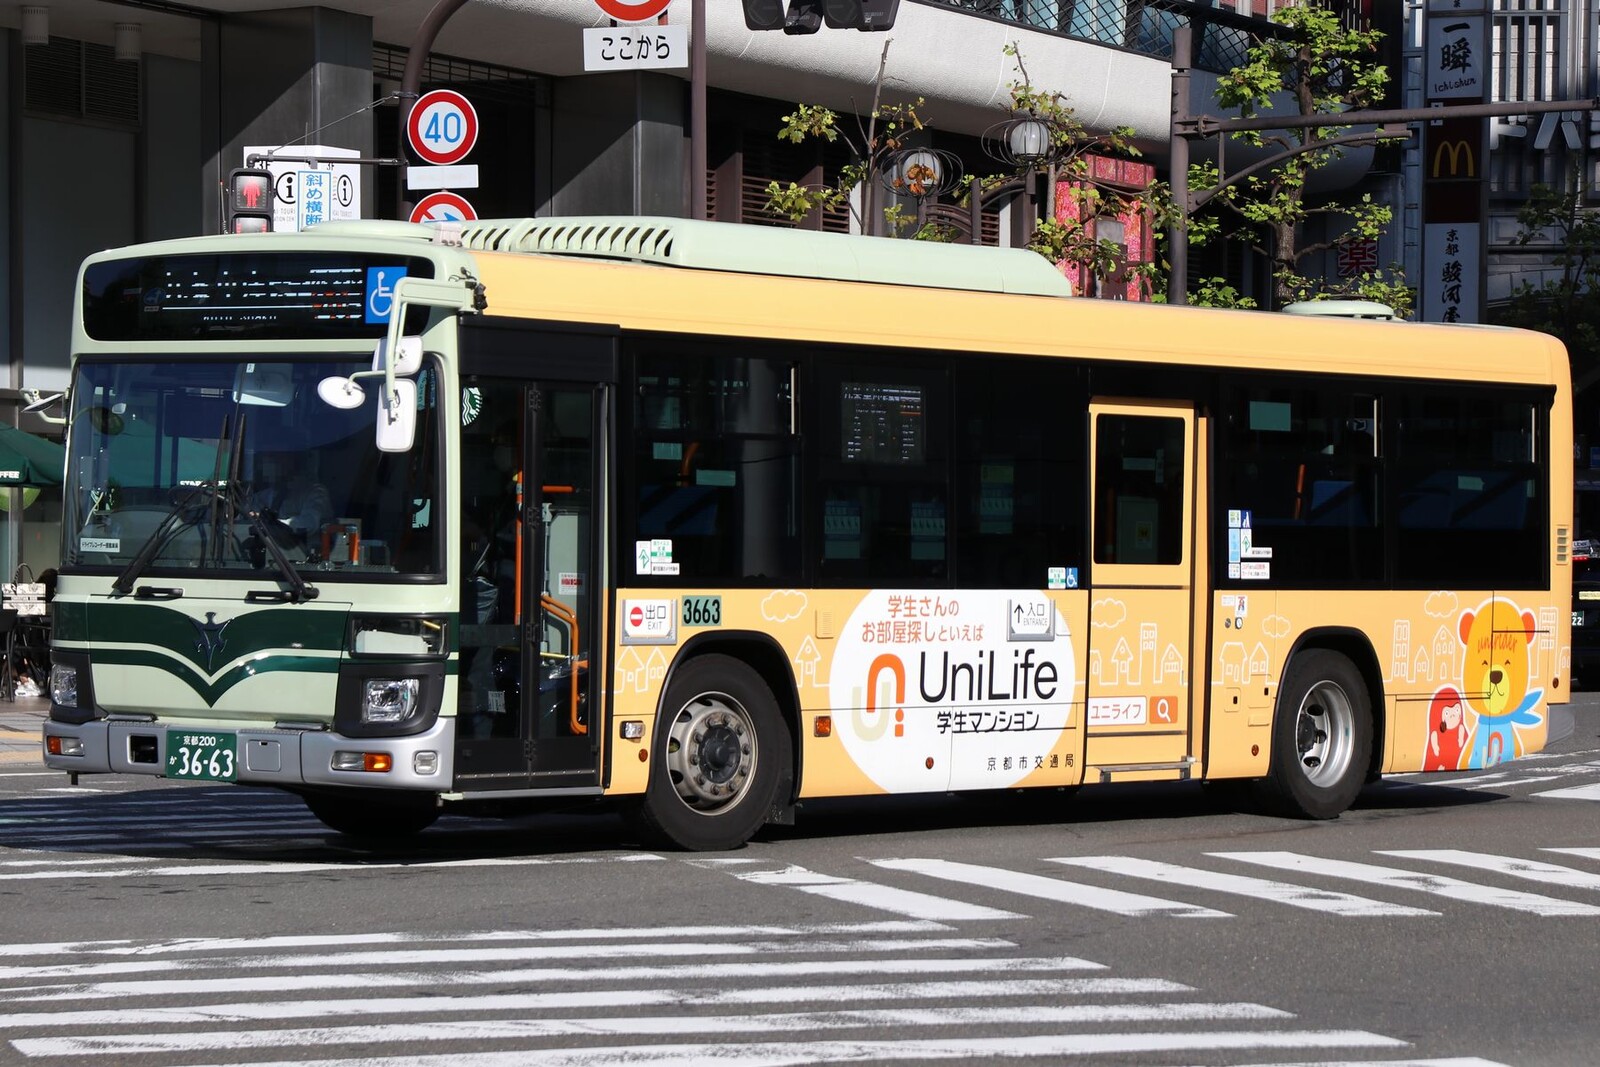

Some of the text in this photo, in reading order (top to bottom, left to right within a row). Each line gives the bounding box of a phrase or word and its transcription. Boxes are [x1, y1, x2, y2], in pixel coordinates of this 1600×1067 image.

[601, 34, 670, 60] ここから
[1440, 22, 1472, 74] 一瞬
[425, 112, 461, 143] 40
[645, 605, 666, 619] 出口
[684, 599, 720, 624] 3663
[888, 596, 959, 618] 学生さんの
[1027, 602, 1045, 616] 入口
[647, 621, 662, 630] EXIT
[862, 621, 984, 644] お部屋探しといえば
[1023, 618, 1048, 626] ENTRANCE
[919, 649, 1058, 702] UniLife
[937, 711, 1039, 734] 学生マンション
[1090, 704, 1142, 719] ユニライフ
[178, 747, 234, 777] 36-63
[986, 753, 1074, 771] 京都市交通局
